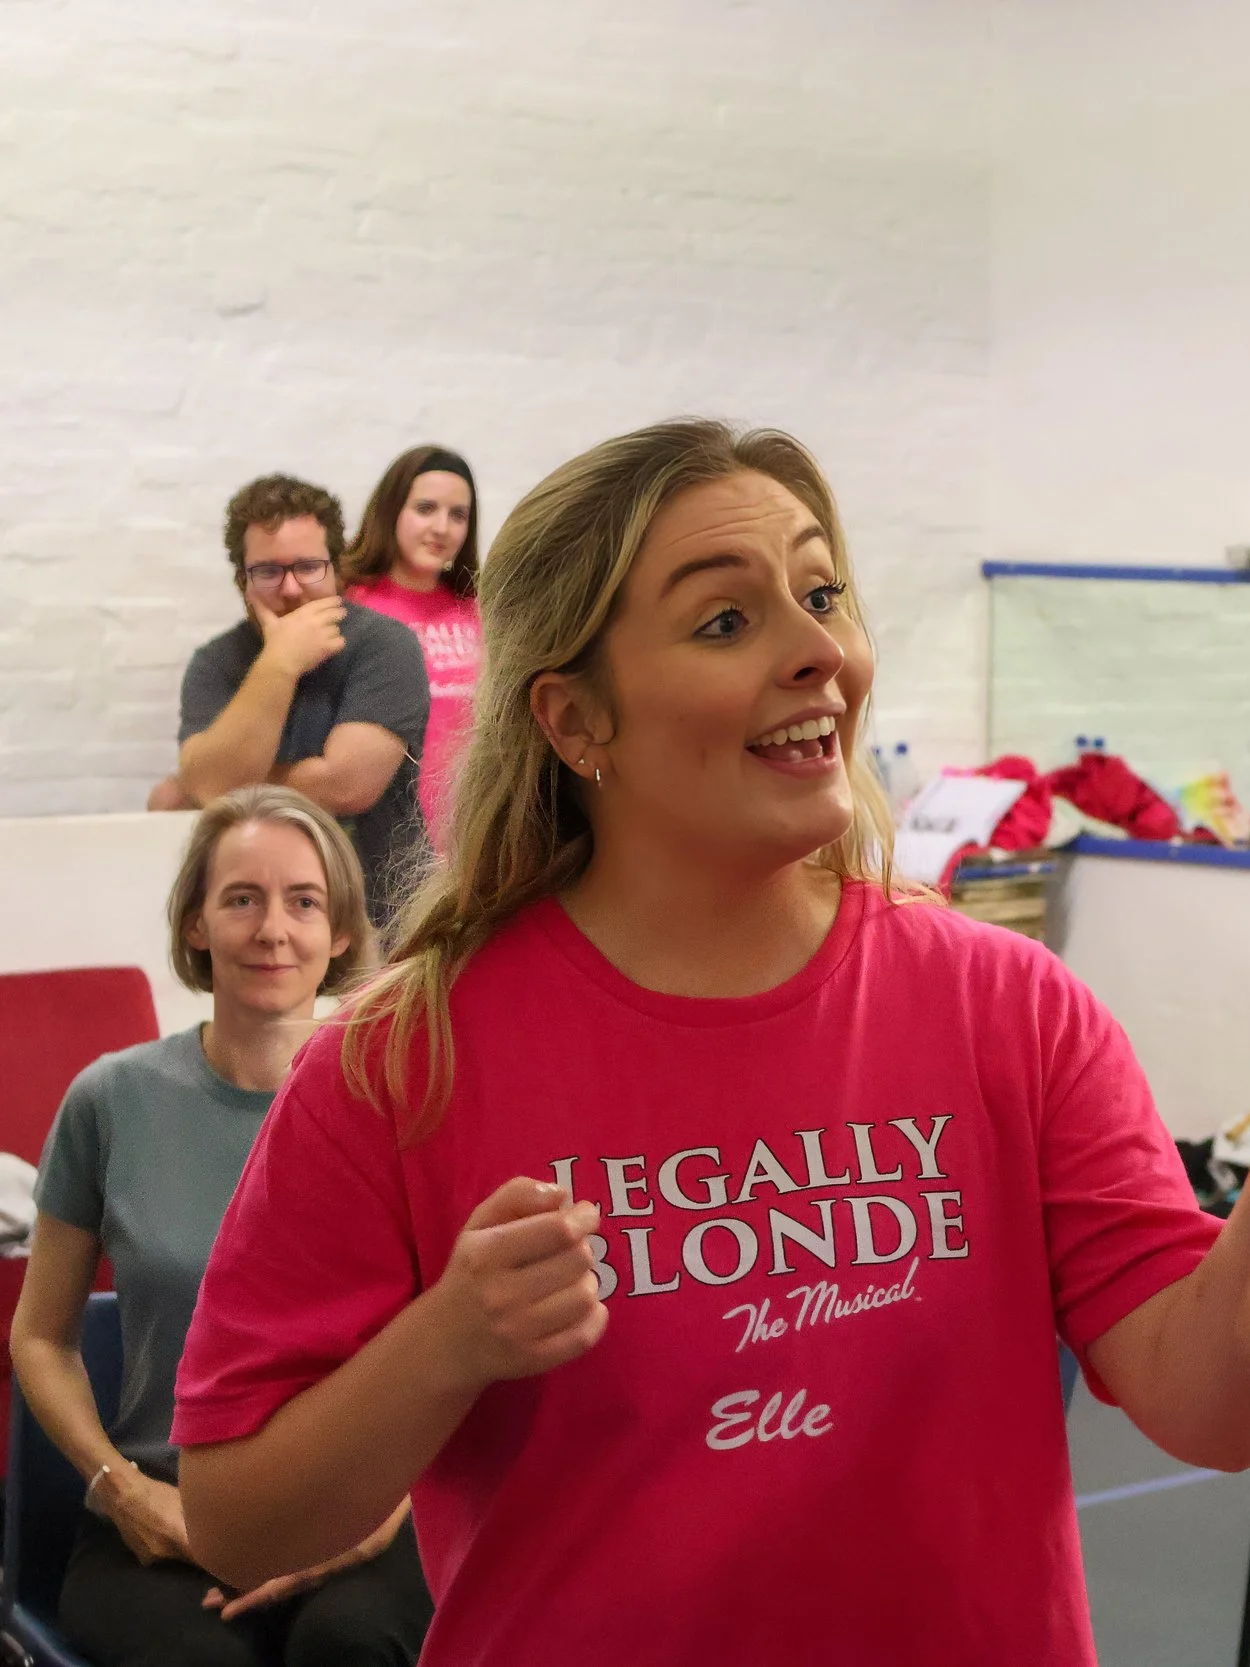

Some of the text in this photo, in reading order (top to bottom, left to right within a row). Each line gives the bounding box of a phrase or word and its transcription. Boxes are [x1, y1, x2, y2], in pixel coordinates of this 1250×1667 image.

[722, 1256, 916, 1353] The Musical
[705, 1388, 834, 1451] Elle
